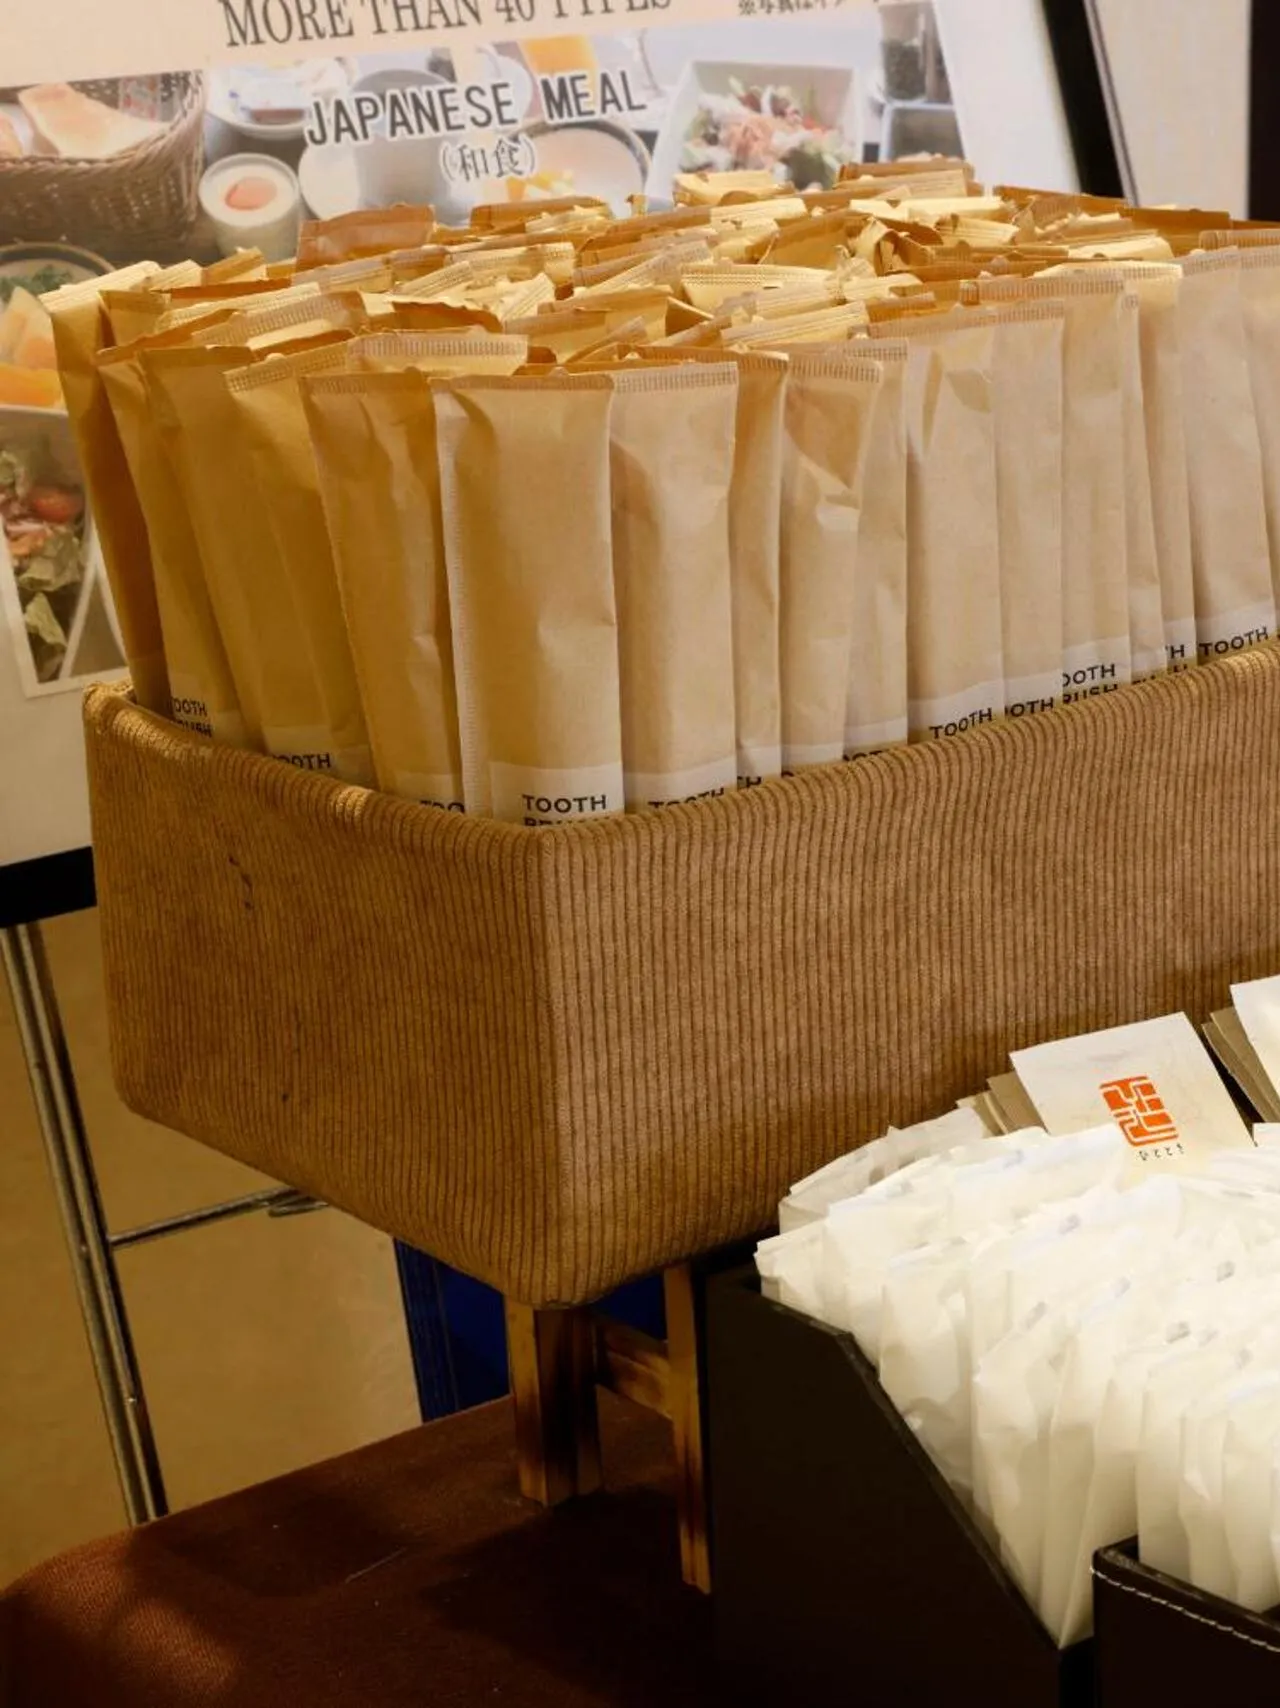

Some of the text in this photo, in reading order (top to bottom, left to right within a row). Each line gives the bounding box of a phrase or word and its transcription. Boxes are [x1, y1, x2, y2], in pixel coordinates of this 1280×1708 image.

[218, 0, 354, 47] MORE
[306, 71, 647, 146] JAPANESE MEAL
[1198, 626, 1269, 657] TOOTH
[929, 707, 992, 740] TOOTH
[522, 794, 607, 814] TOOTH
